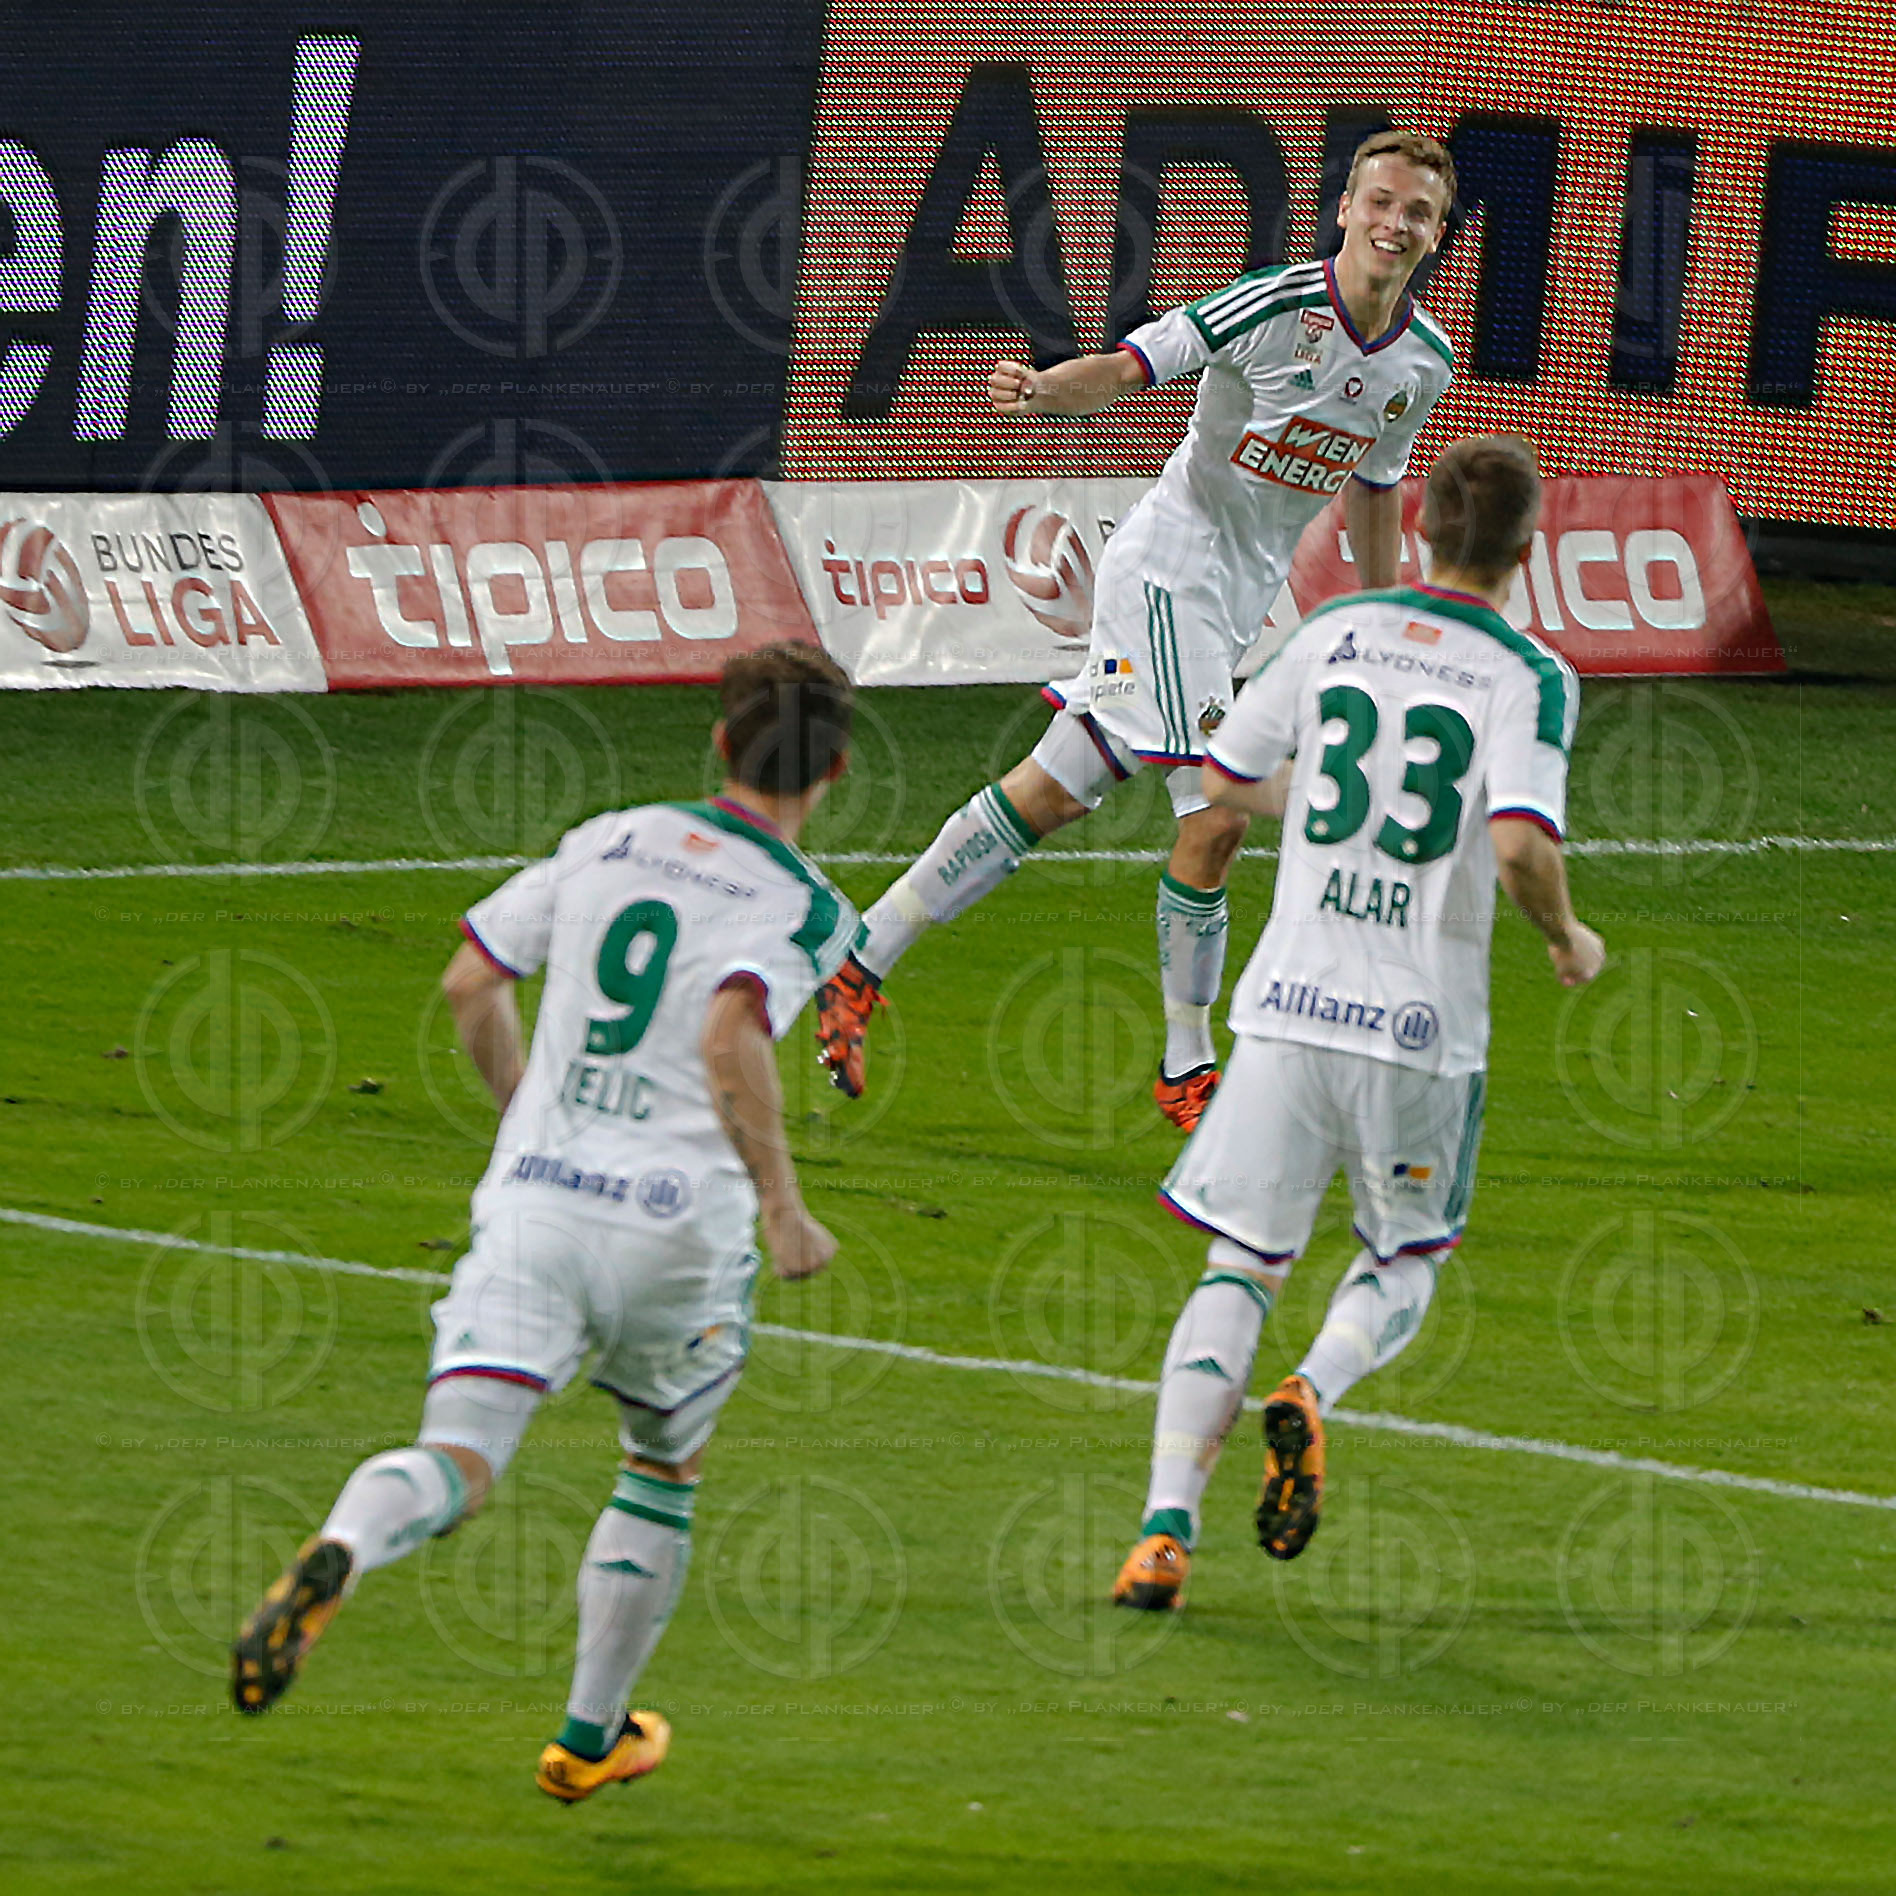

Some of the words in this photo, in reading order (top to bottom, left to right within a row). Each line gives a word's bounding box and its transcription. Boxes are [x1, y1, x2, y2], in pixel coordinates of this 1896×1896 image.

[1284, 423, 1369, 464] WIEN
[91, 532, 244, 573] BUNDES
[346, 500, 739, 675] tipico
[821, 540, 989, 619] tipico
[104, 577, 282, 648] LIGA
[1304, 684, 1475, 865] 33
[1320, 867, 1411, 929] ALAR
[585, 899, 678, 1057] 9
[1260, 980, 1385, 1031] Allianz
